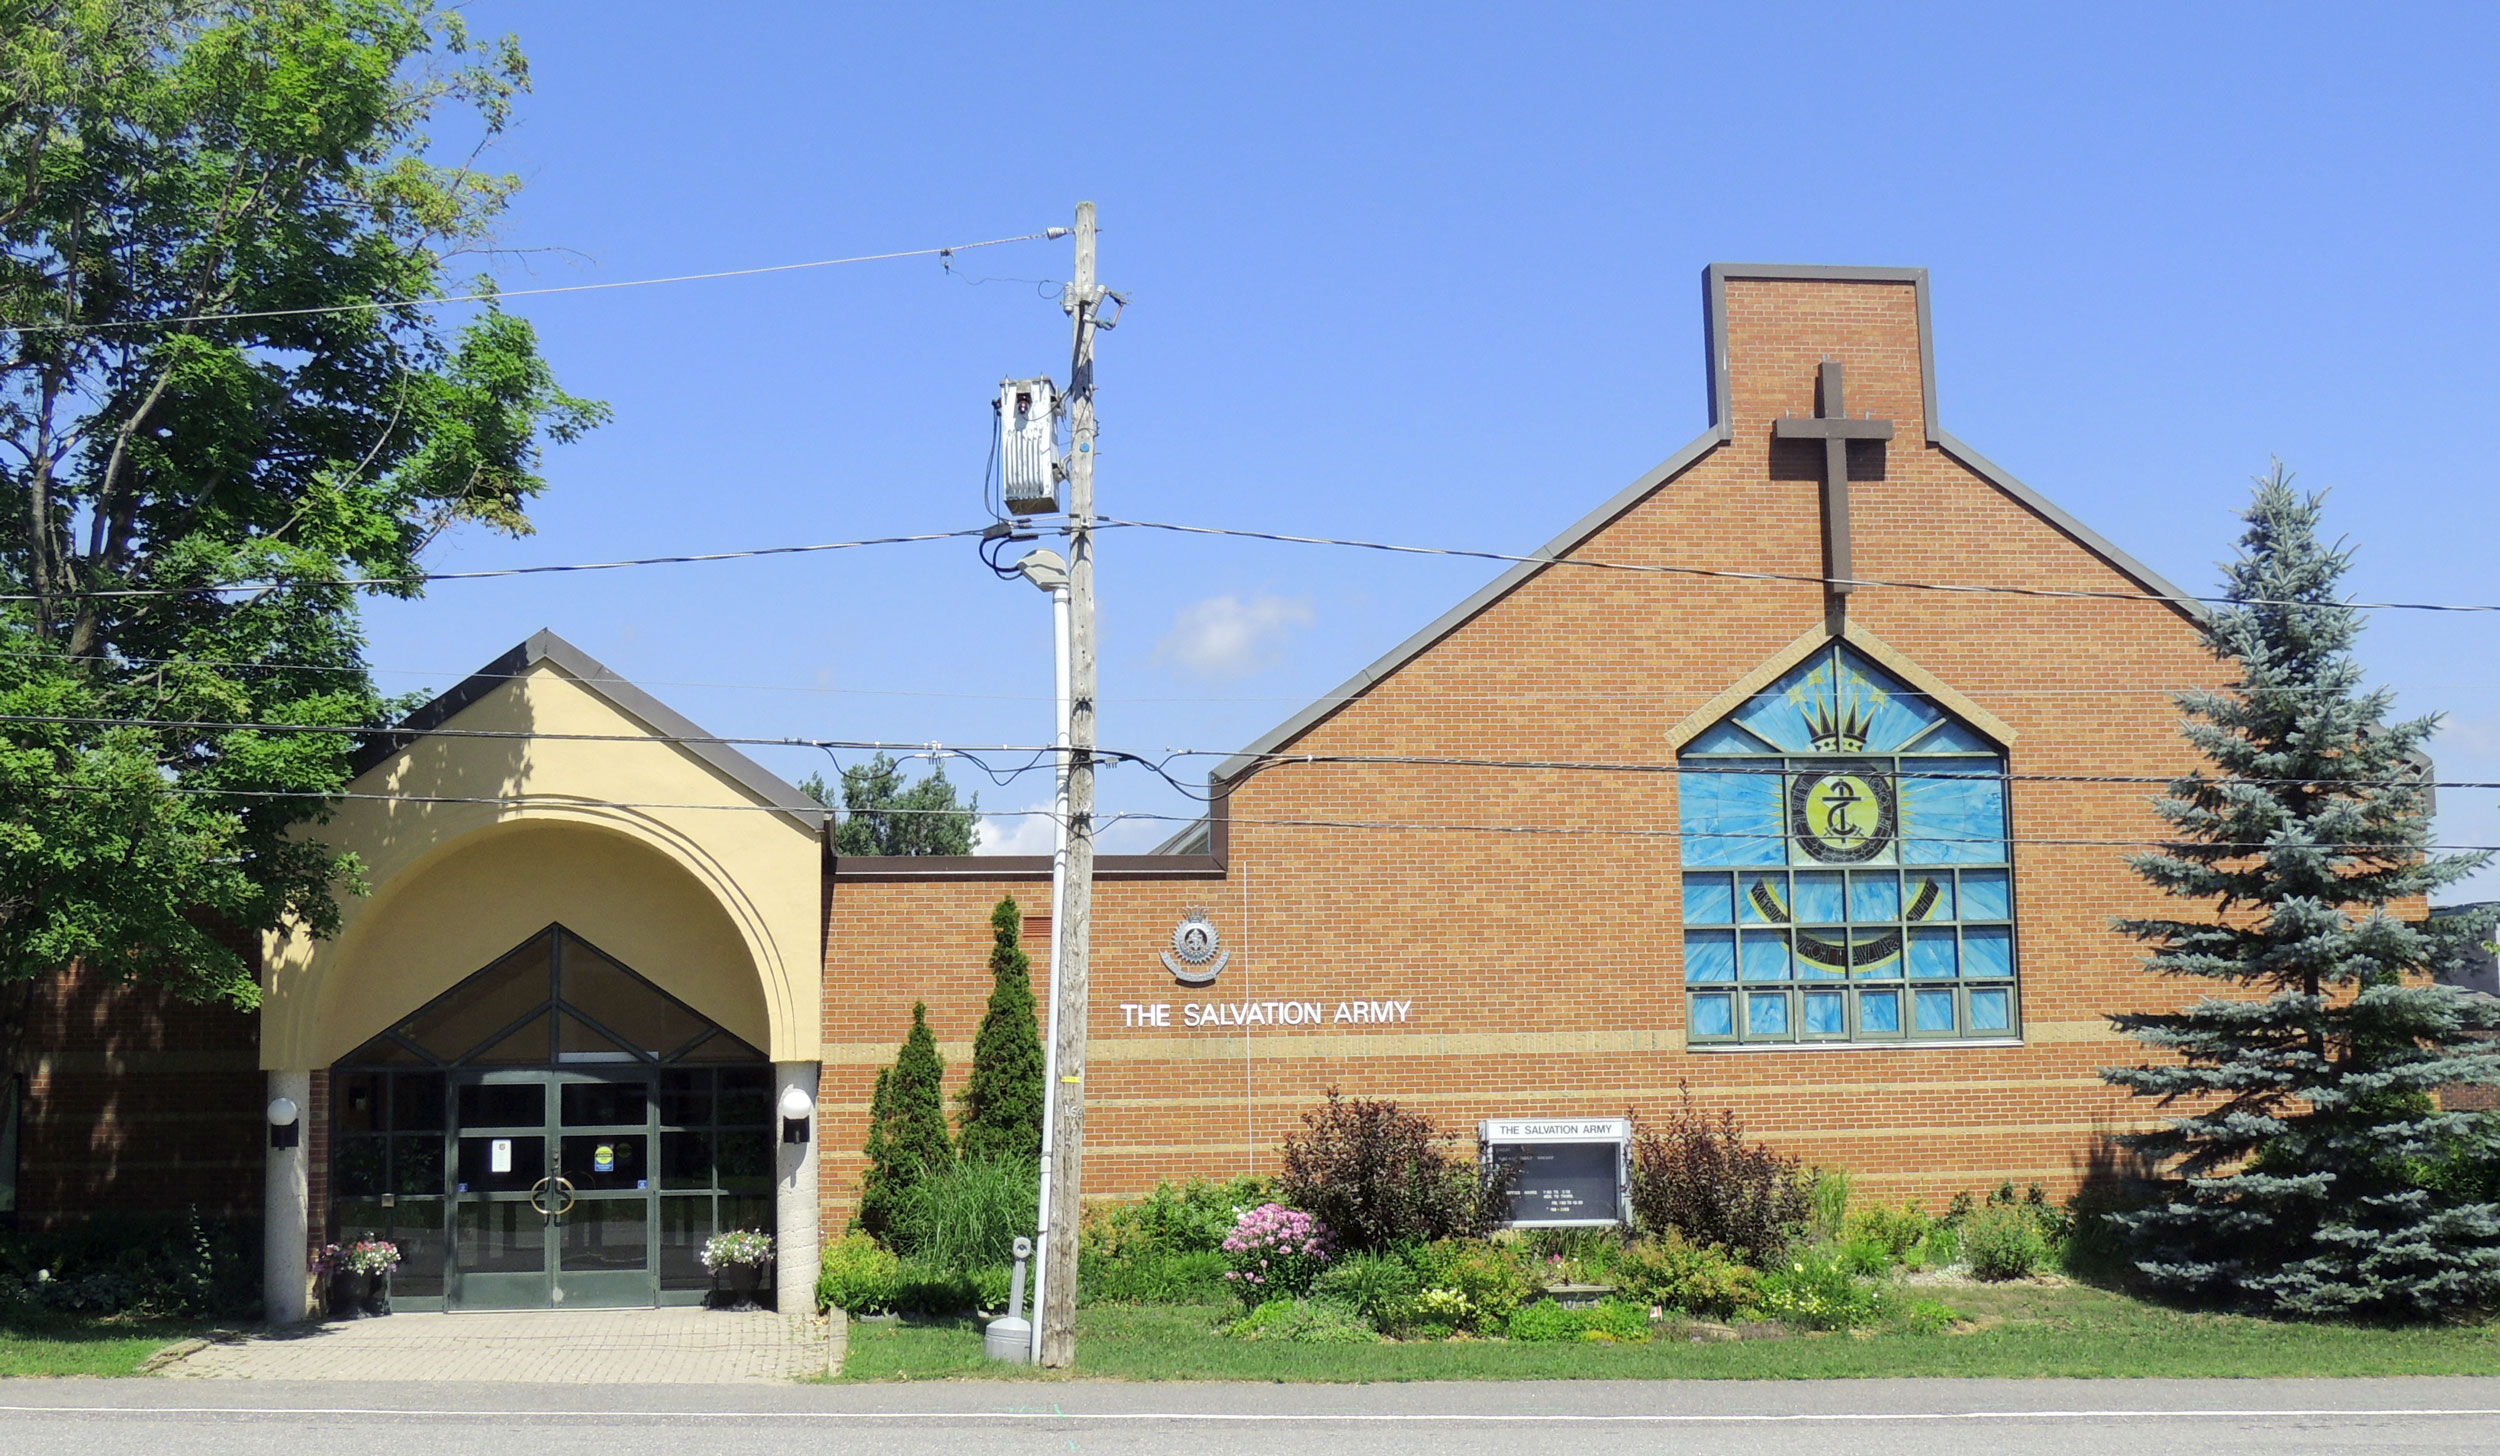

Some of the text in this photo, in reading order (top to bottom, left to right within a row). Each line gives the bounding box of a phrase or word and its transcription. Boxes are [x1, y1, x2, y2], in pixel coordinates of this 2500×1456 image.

[1120, 1000, 1411, 1027] THE SALVATION ARMY
[1500, 1124, 1612, 1135] THE SALVATION ARMY
